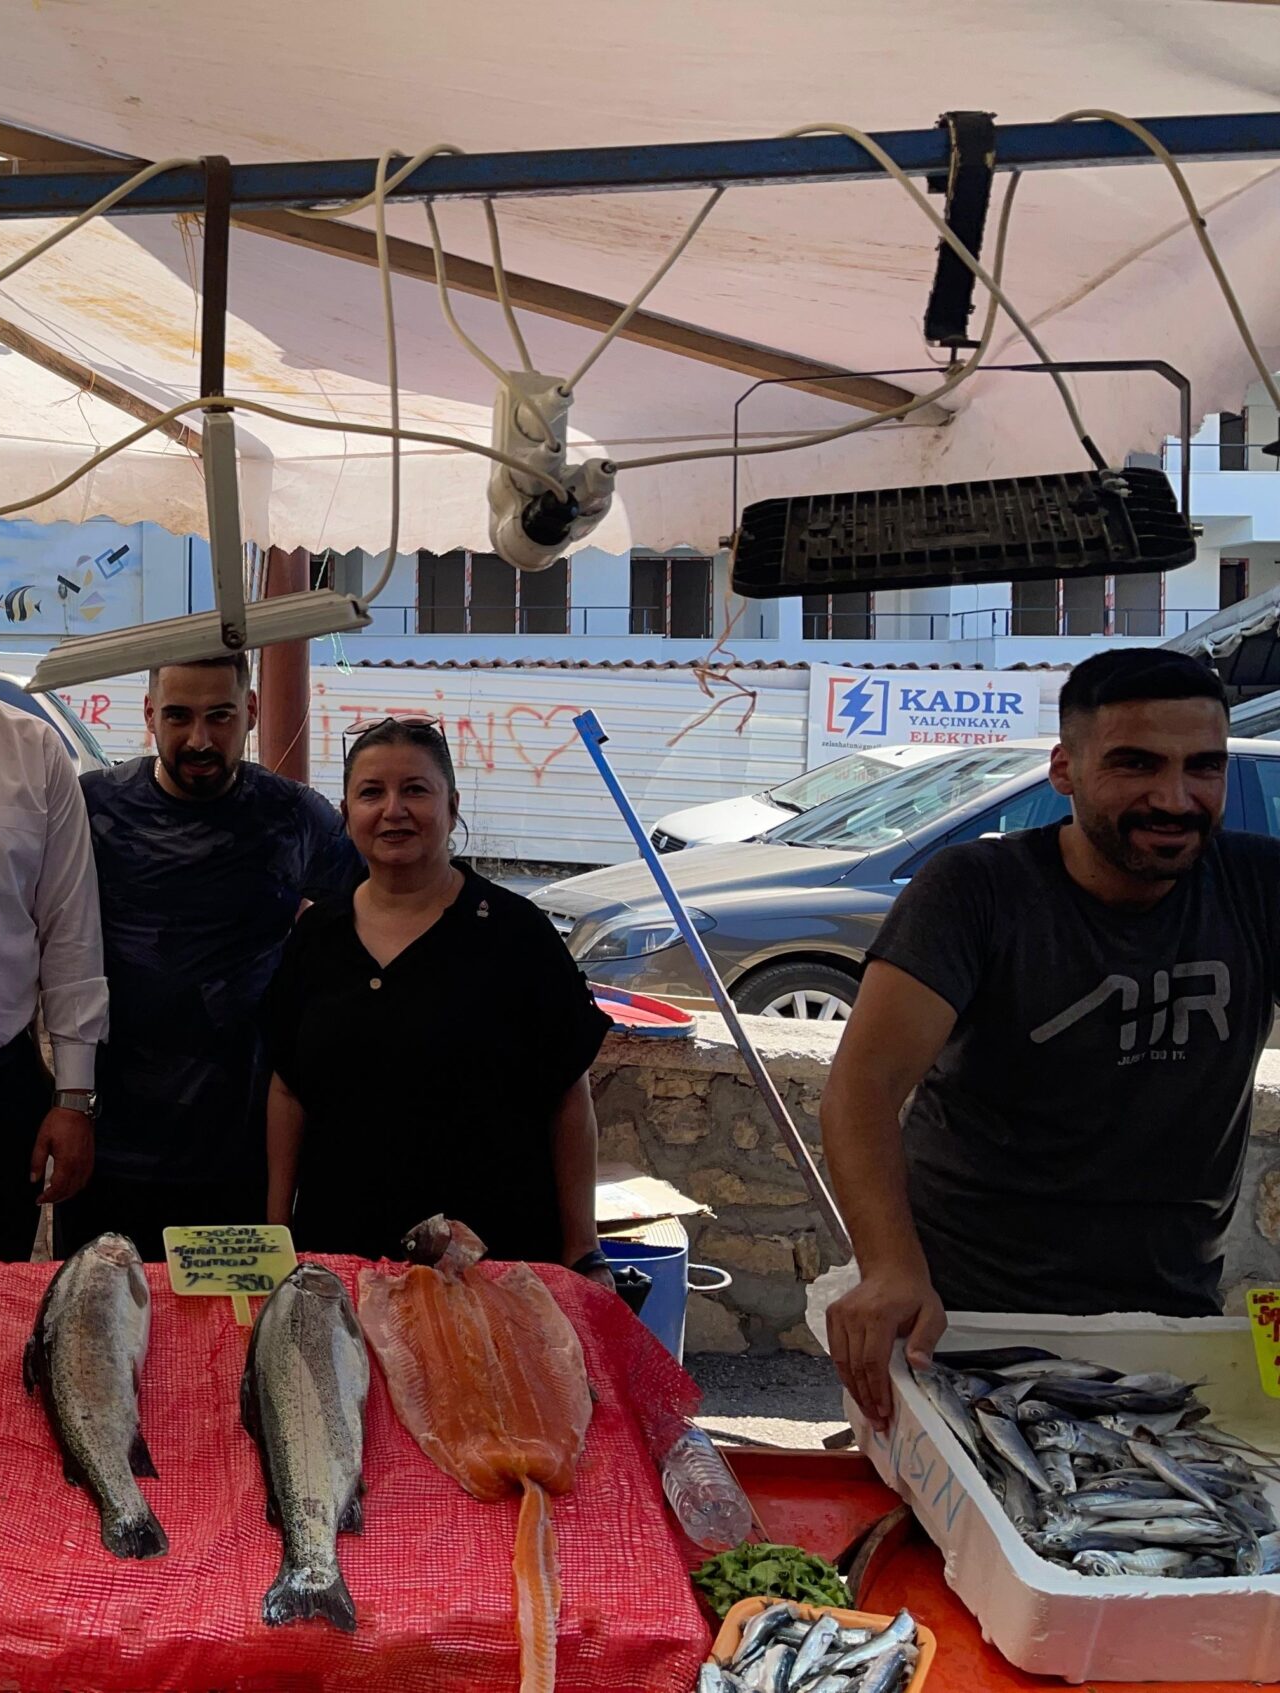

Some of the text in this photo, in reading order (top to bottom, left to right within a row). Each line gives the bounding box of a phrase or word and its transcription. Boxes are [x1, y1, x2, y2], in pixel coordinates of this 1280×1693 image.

[899, 681, 1024, 715] KADİR
[909, 716, 1011, 729] YALÇINKAYA
[910, 731, 1008, 745] ELEKTRİK
[226, 1273, 274, 1291] 350
